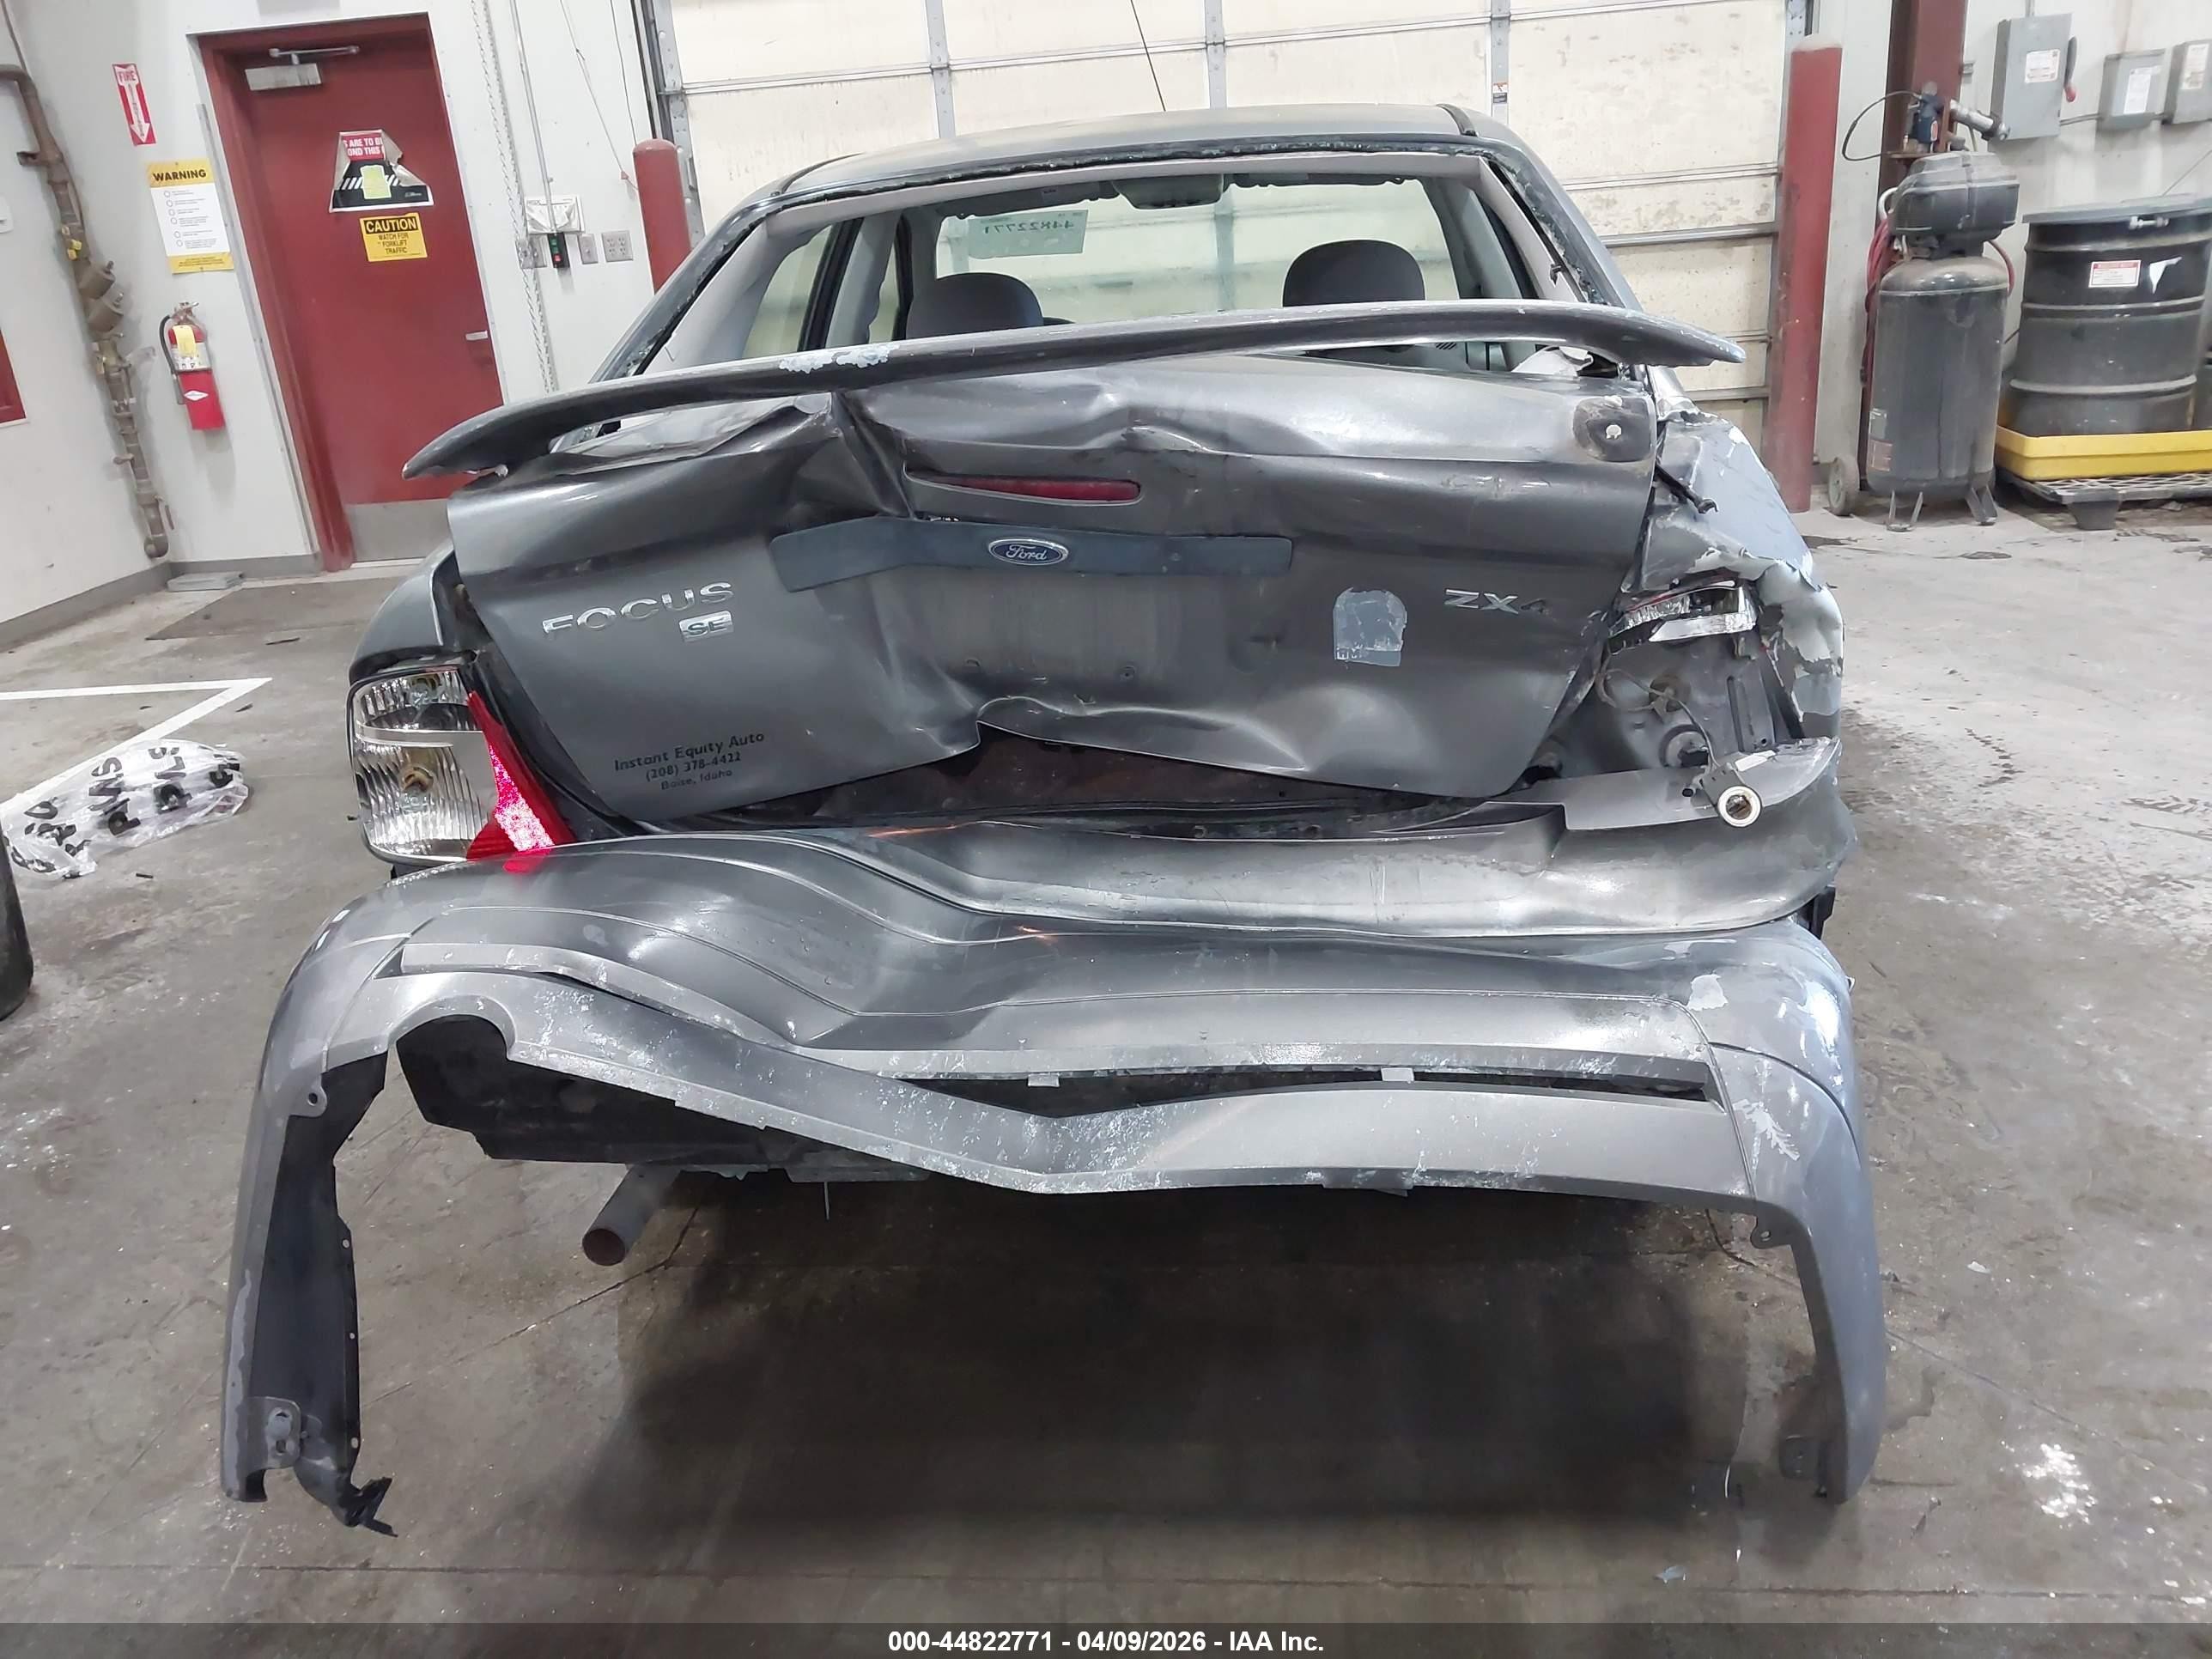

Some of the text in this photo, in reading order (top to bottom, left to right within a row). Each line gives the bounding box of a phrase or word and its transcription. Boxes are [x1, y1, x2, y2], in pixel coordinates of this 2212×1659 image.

[118, 70, 137, 82] FIRE
[349, 138, 364, 148] ARE
[364, 137, 374, 146] TO
[364, 146, 380, 155] THIS
[153, 169, 207, 181] WARNING
[366, 217, 417, 233] CAUTION
[379, 233, 397, 241] WATCH
[382, 239, 408, 247] FORKLIFT
[1006, 544, 1048, 561] Ford
[543, 581, 734, 635] FOCUS
[687, 617, 731, 636] SE
[614, 732, 764, 772] Instant Equity Auto
[645, 764, 679, 782] (208)
[700, 769, 733, 782] Idaho
